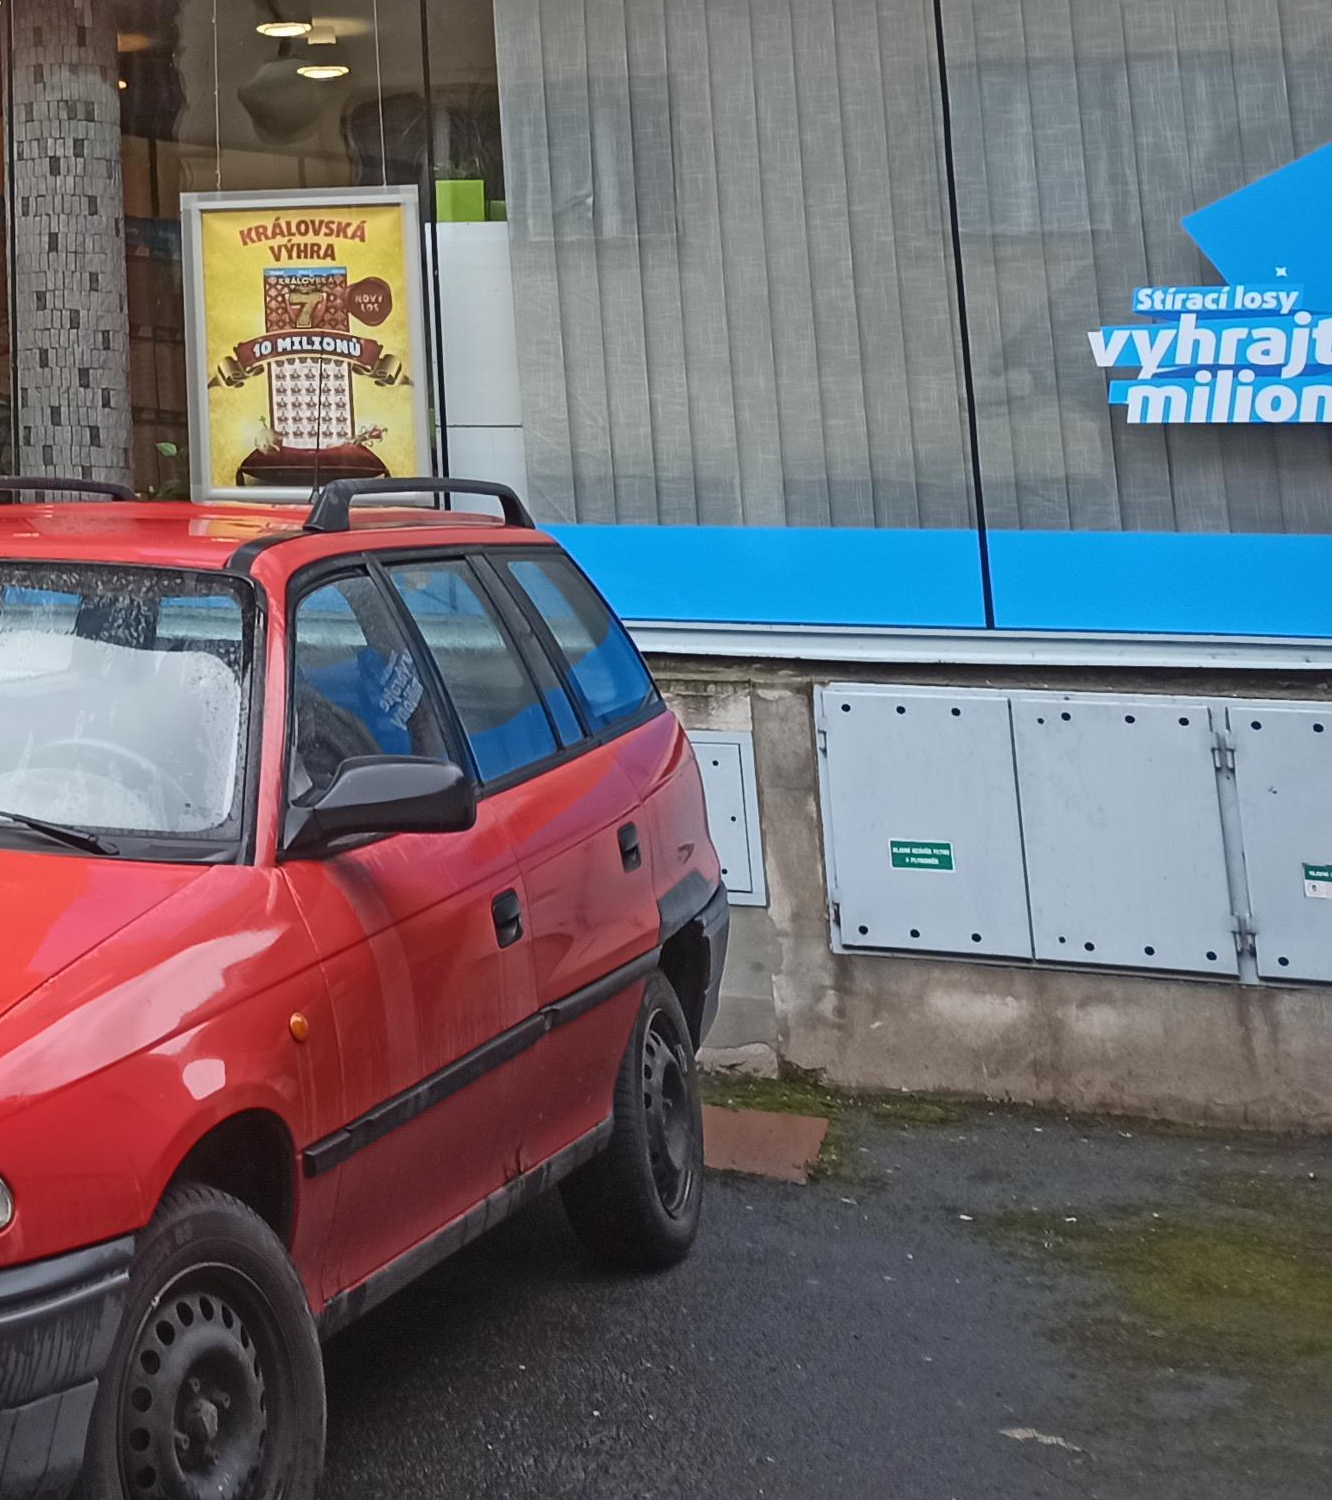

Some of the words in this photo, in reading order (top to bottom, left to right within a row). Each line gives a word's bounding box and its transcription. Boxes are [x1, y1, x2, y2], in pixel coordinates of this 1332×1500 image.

[239, 216, 367, 246] KRÁLOVSKÁ
[269, 239, 336, 262] VÝHRA
[289, 291, 324, 328] 7
[360, 304, 380, 312] LOS
[1137, 286, 1230, 311] Stírací
[1234, 285, 1299, 314] losy
[253, 341, 272, 357] 10
[277, 336, 361, 357] MILIONŮ
